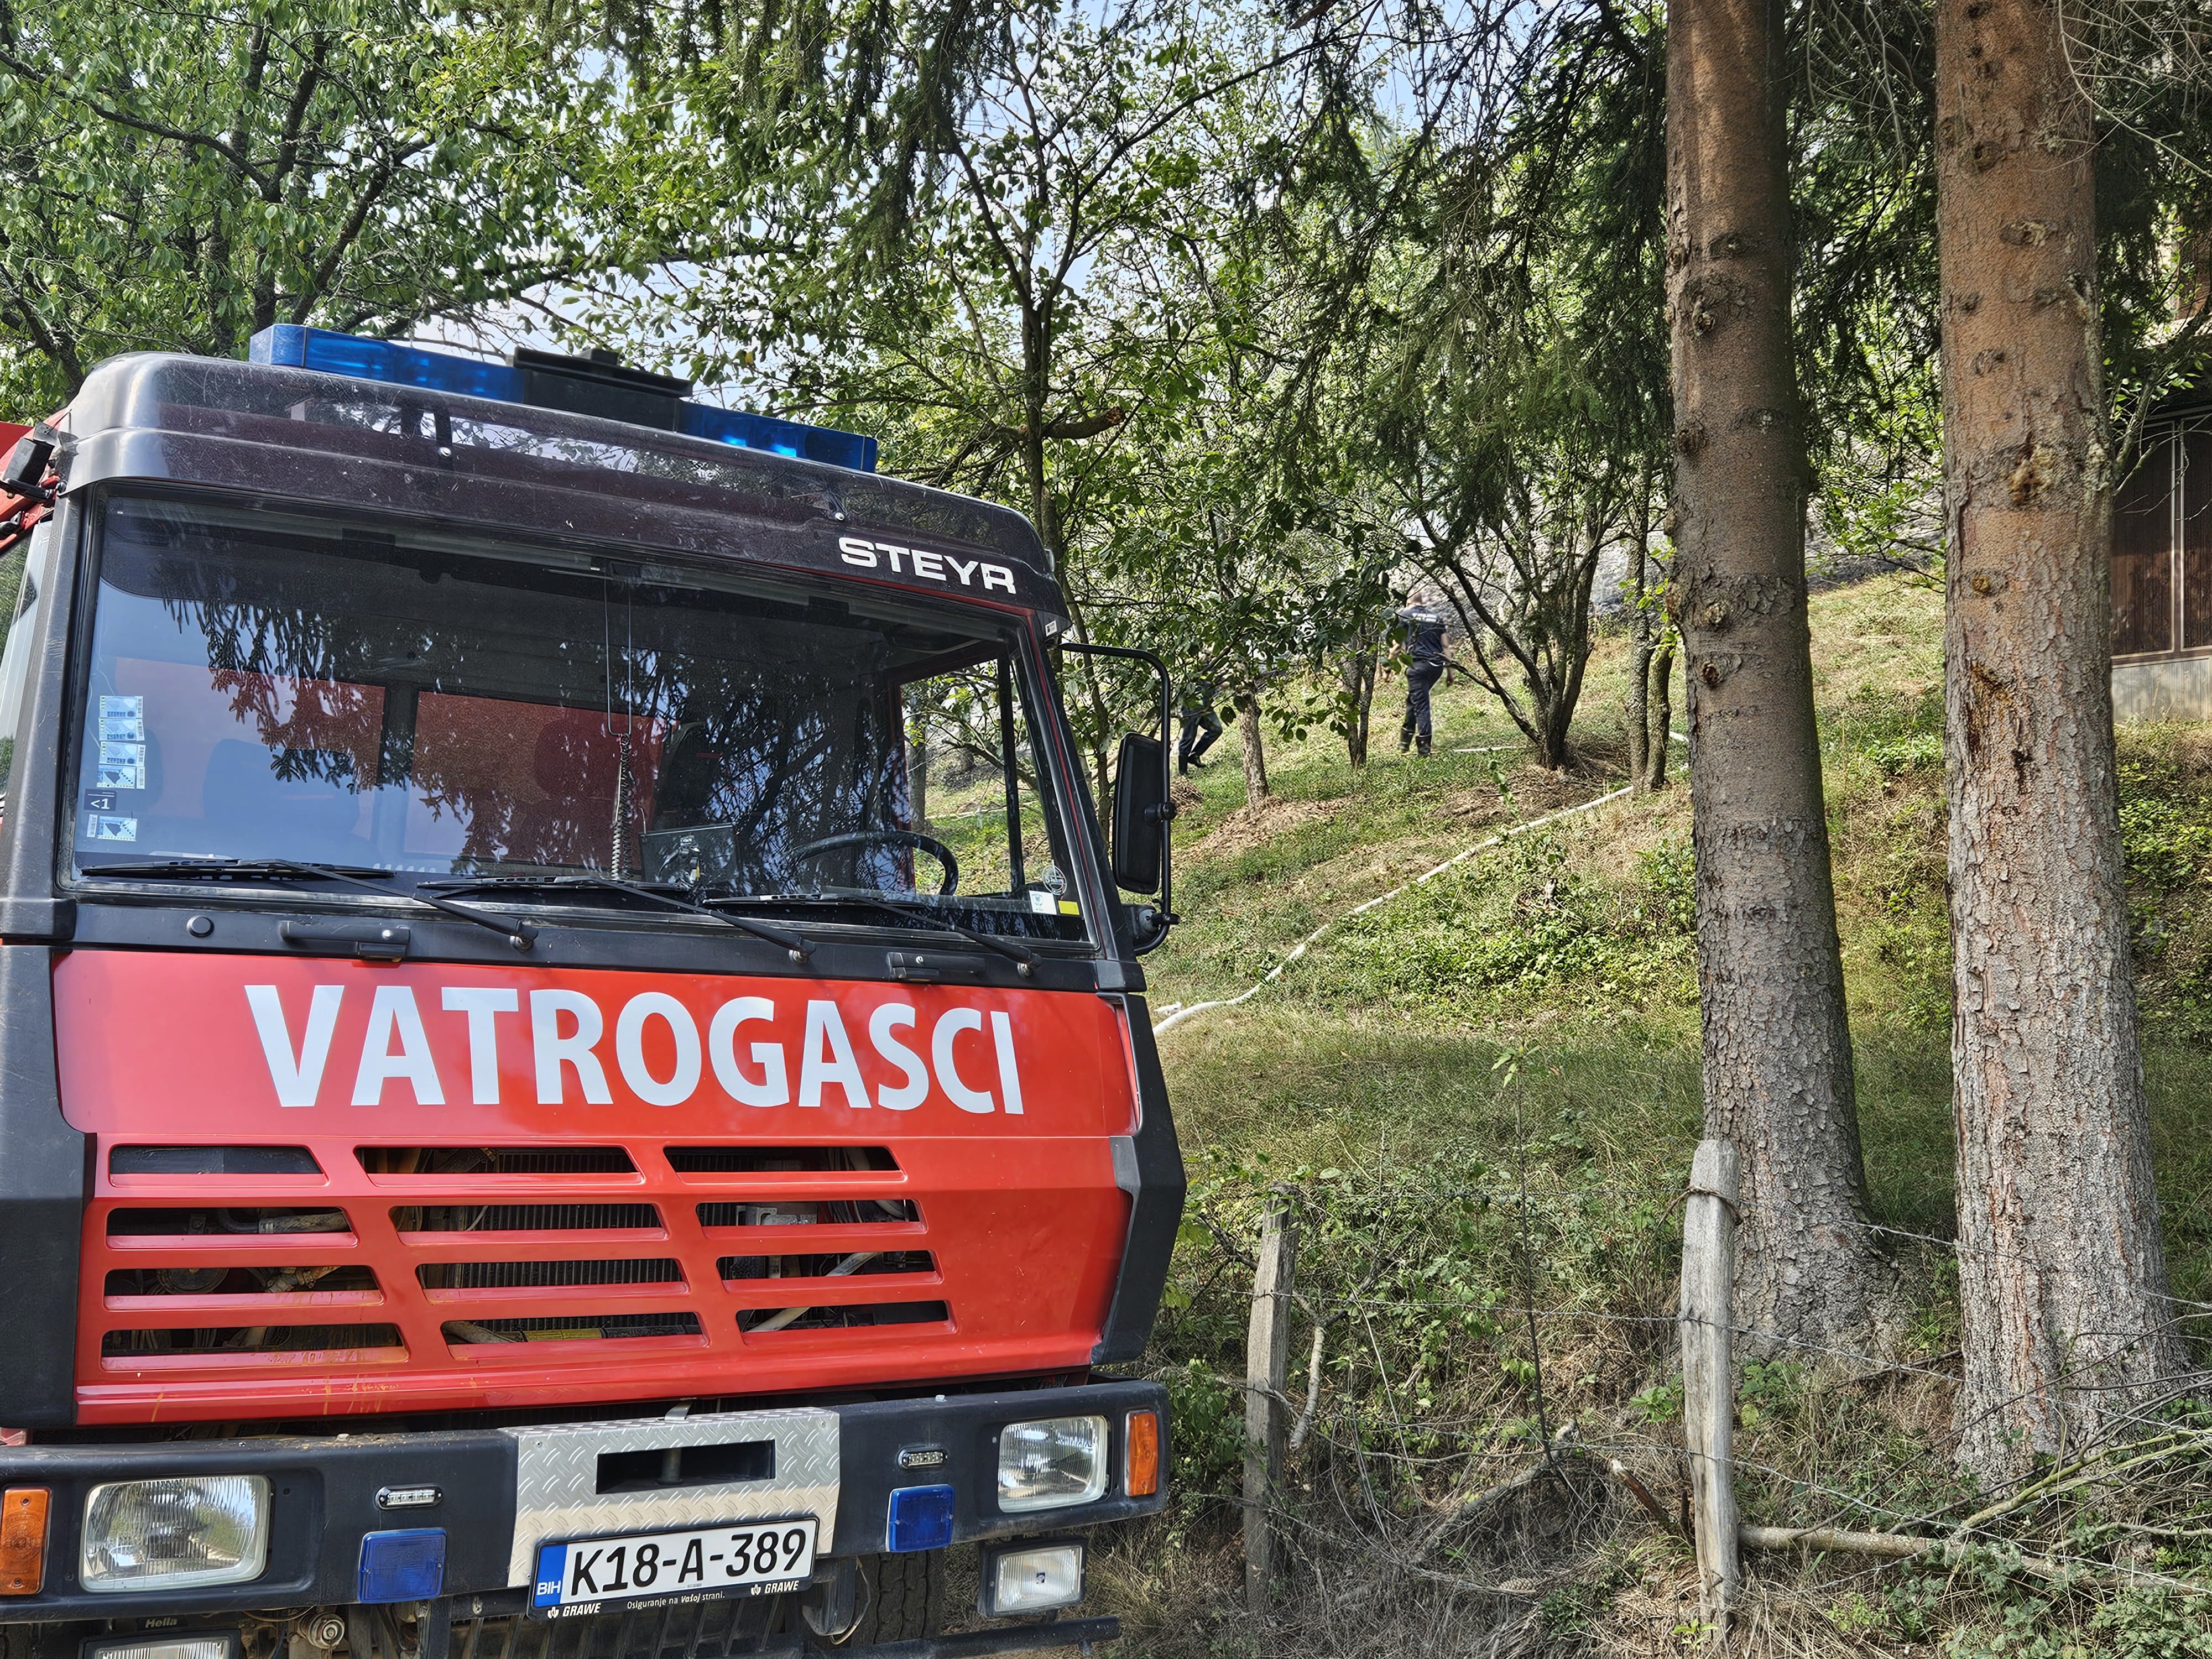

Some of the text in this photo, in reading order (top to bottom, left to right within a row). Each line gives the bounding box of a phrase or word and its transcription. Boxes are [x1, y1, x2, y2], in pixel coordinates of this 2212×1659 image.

[838, 537, 1016, 594] STEYR
[244, 984, 1024, 1115] VATROGASCI
[571, 1528, 806, 1596] K18-A-389
[536, 1580, 561, 1595] BIH
[764, 1580, 800, 1594] GRAWE
[627, 1598, 666, 1610] Osiguranje
[702, 1590, 726, 1601] strani.
[562, 1603, 602, 1617] GRAWE
[145, 1617, 178, 1629] Hella
